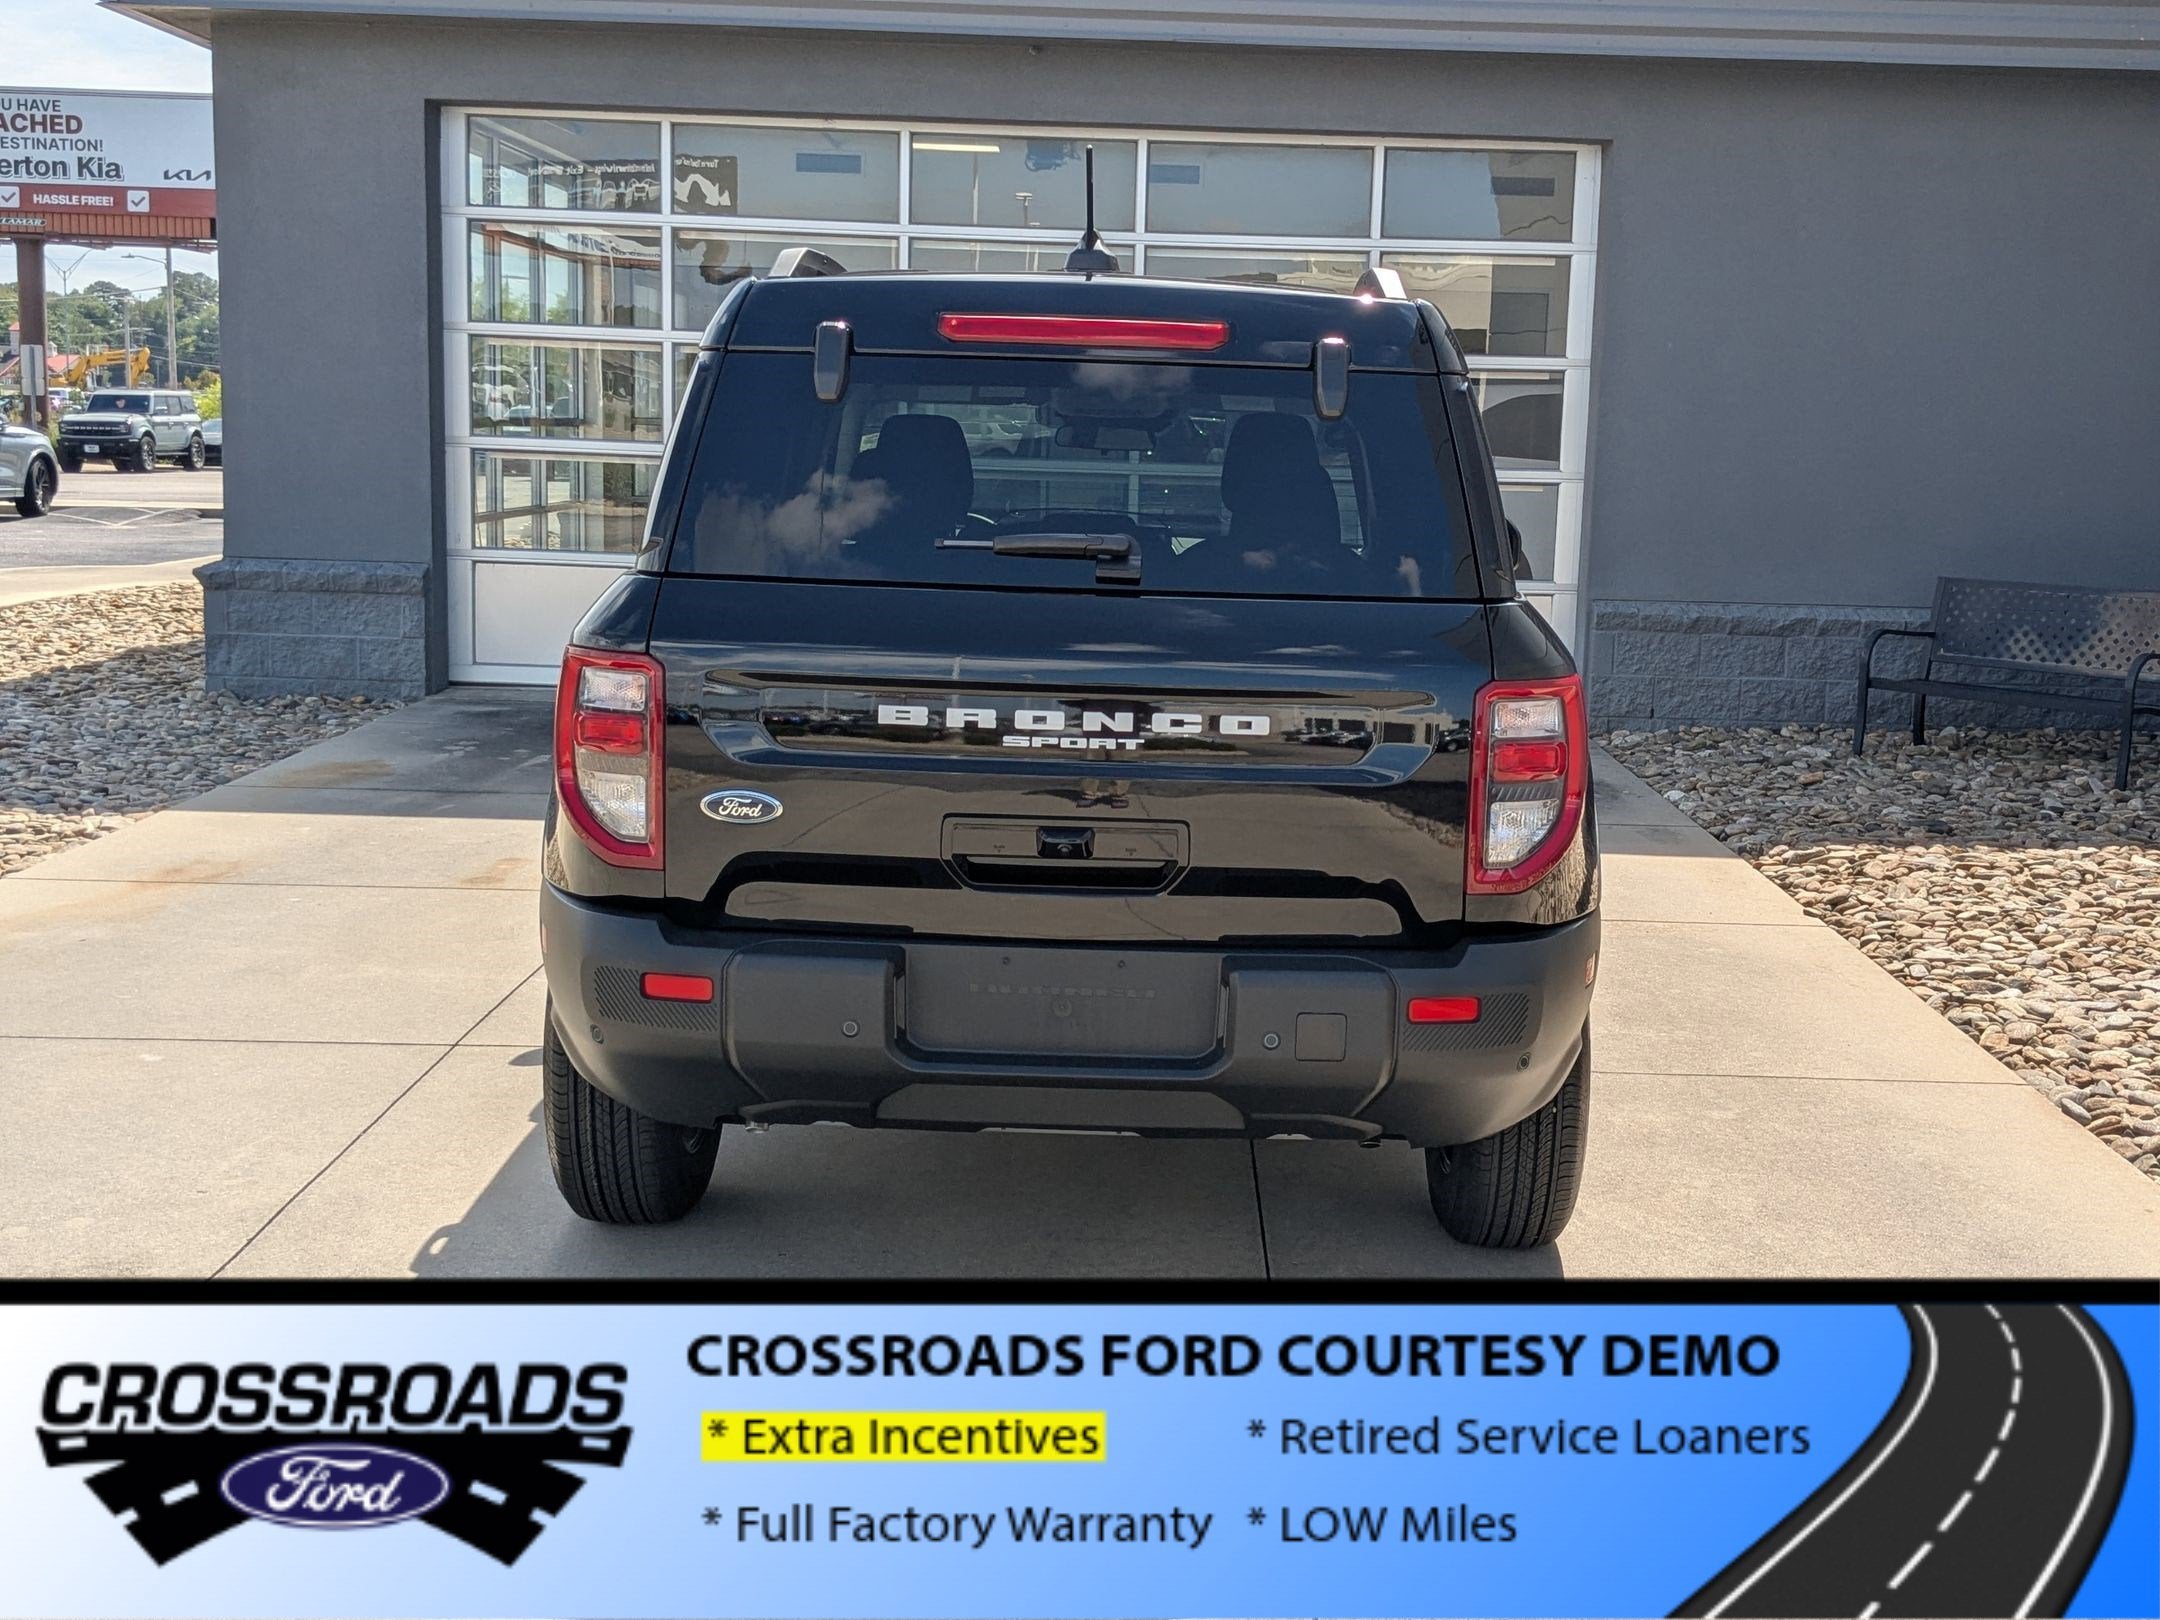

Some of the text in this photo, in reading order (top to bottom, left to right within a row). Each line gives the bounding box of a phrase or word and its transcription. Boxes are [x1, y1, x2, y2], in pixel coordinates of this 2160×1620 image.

[17, 98, 62, 112] HAVE
[77, 156, 125, 181] Kia
[33, 194, 114, 207] HASSLE FREE!
[877, 704, 1270, 736] BRONCO
[1002, 735, 1144, 751] SPORT
[718, 797, 763, 817] Ford
